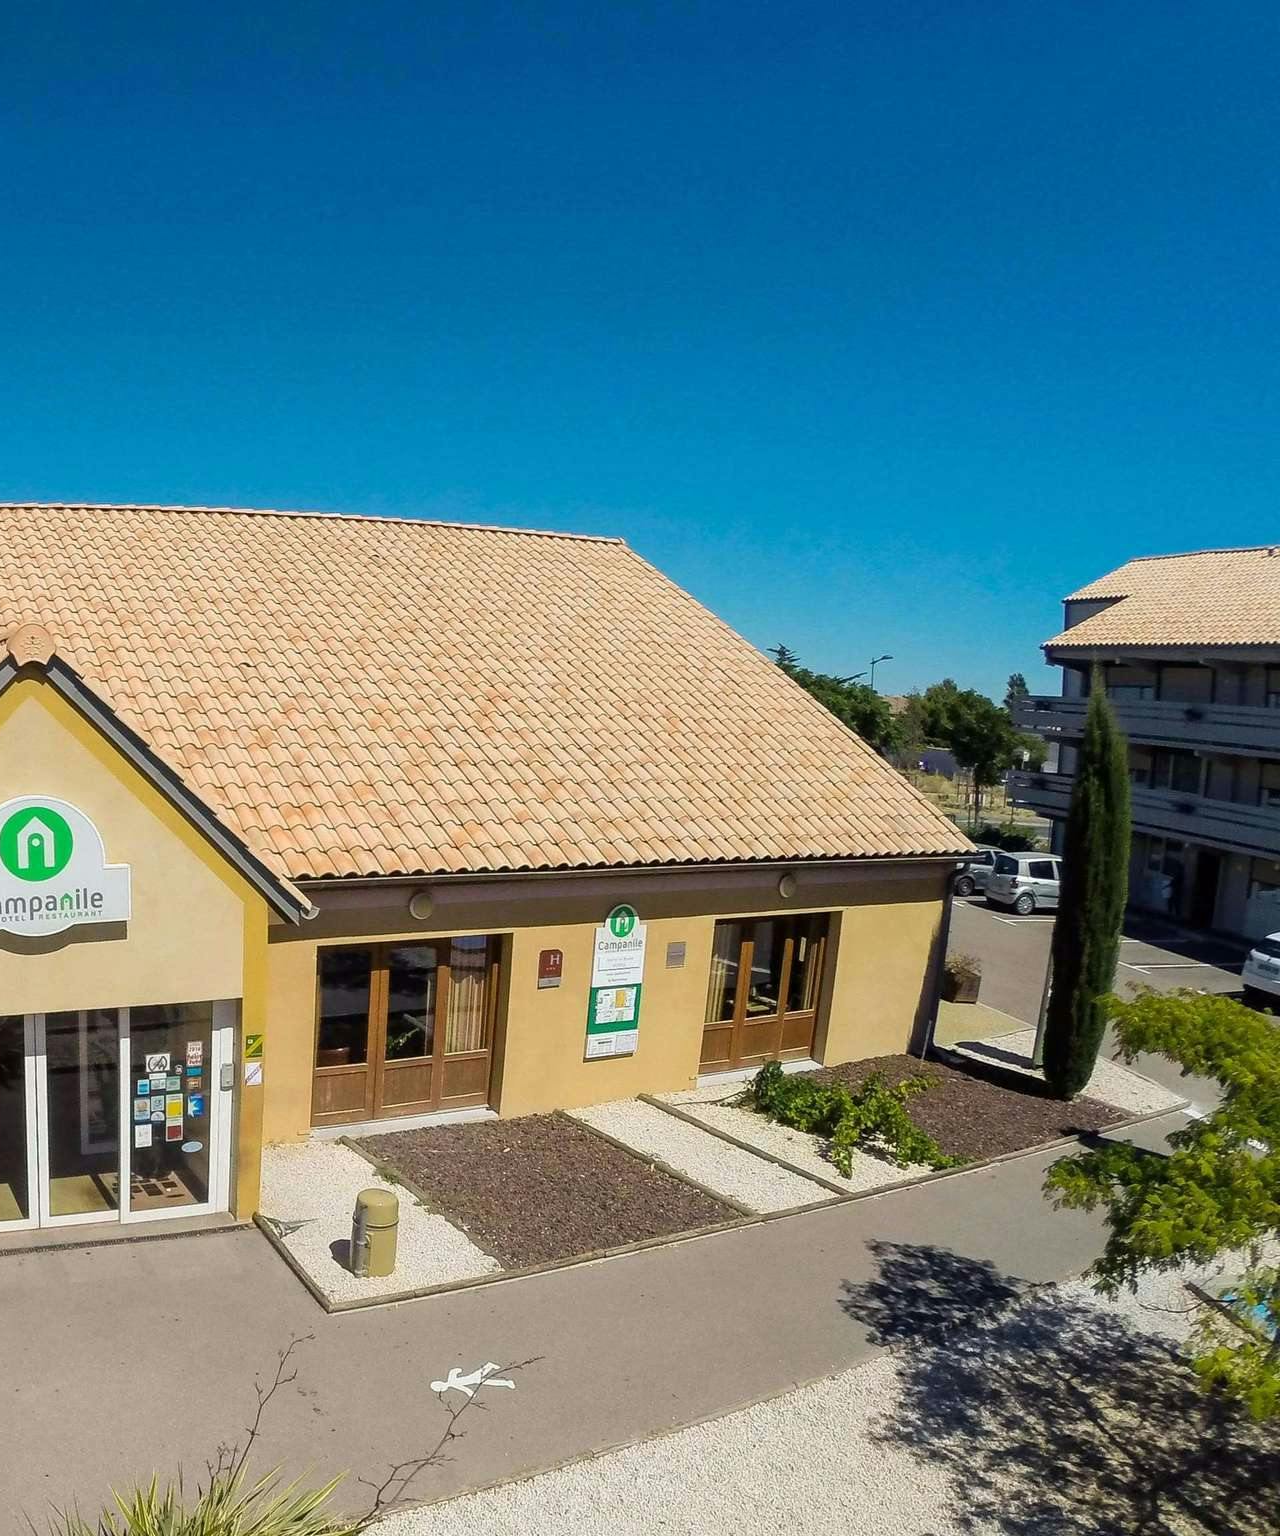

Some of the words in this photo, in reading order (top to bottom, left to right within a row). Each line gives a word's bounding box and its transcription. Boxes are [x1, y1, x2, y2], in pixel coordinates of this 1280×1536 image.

[39, 911, 103, 920] RESTAURANT
[598, 938, 643, 952] Campanile
[550, 954, 560, 965] H
